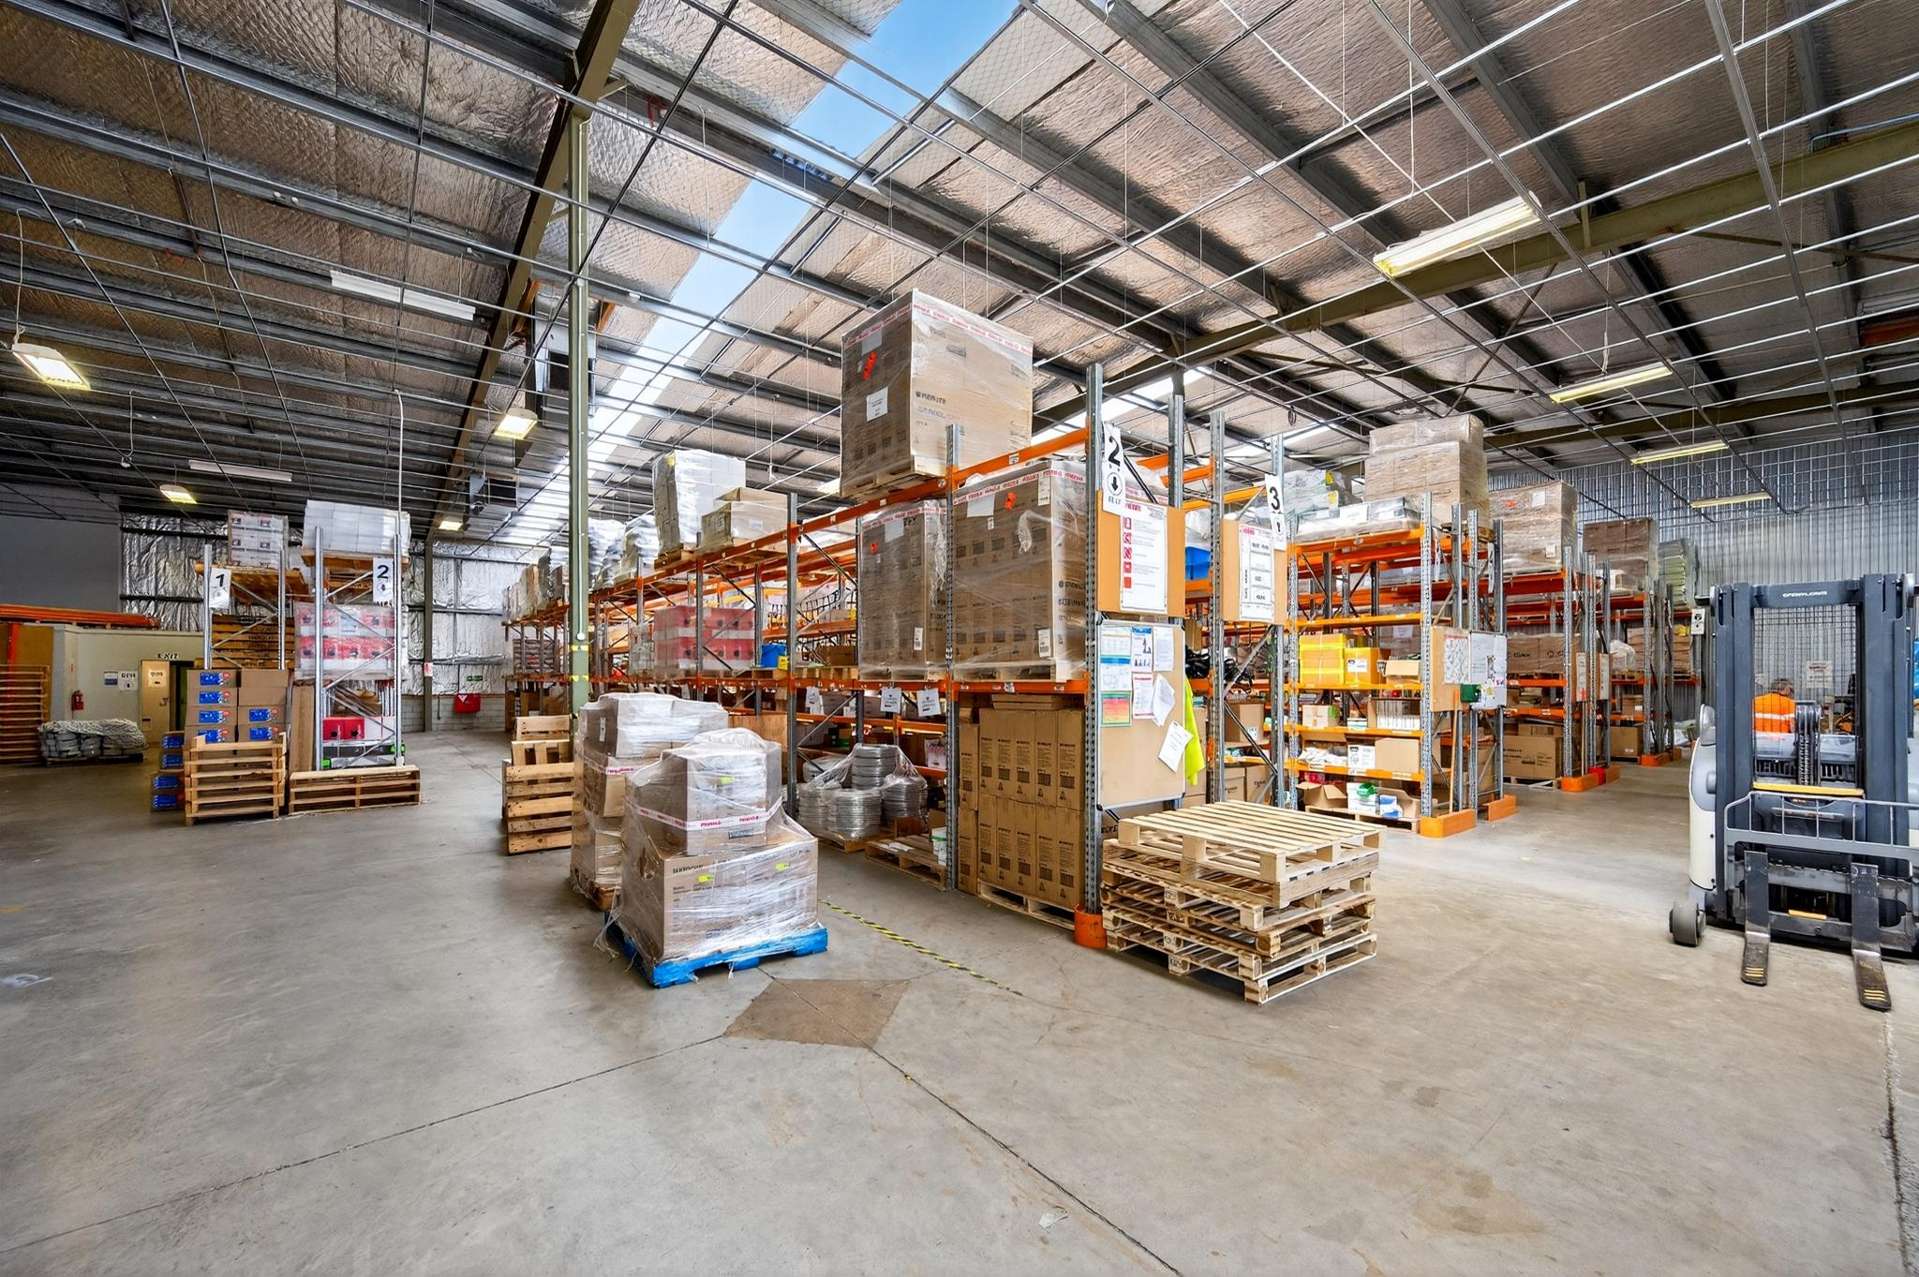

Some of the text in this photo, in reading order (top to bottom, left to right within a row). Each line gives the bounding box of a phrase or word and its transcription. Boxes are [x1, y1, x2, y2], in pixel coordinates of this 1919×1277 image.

[1107, 435, 1121, 468] 2
[1269, 486, 1281, 511] 3
[215, 573, 225, 588] 1
[377, 564, 390, 580] 2
